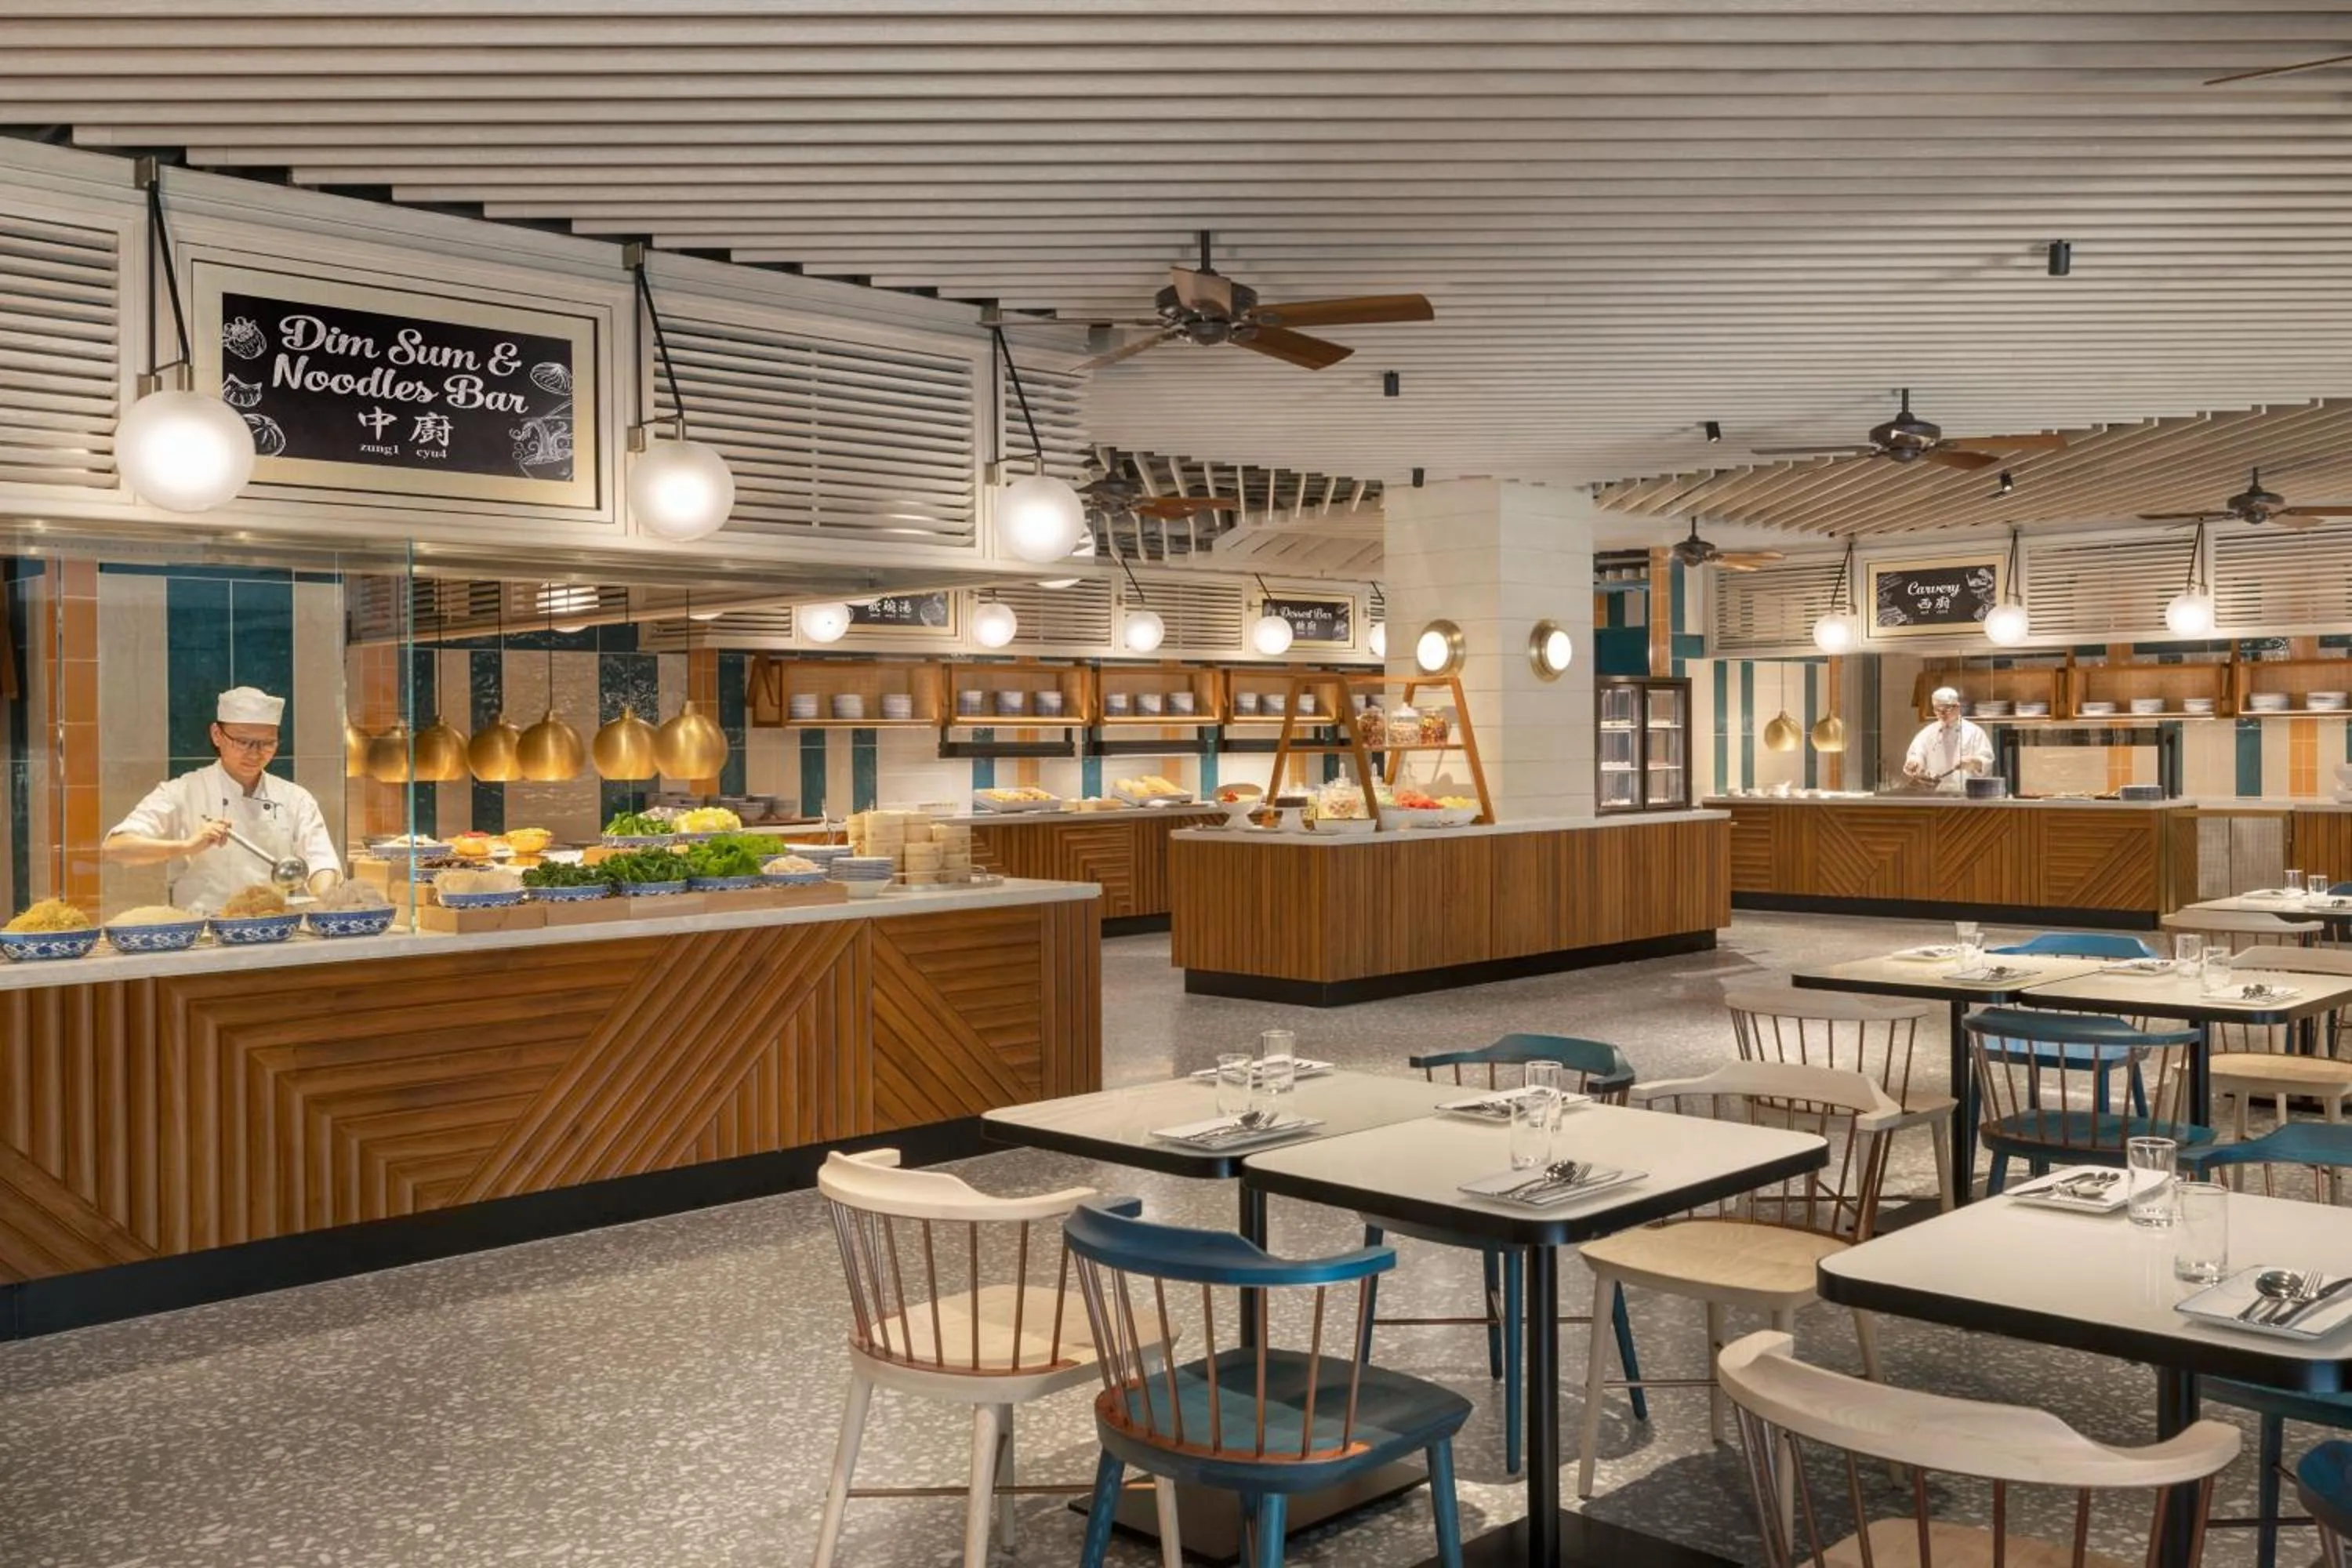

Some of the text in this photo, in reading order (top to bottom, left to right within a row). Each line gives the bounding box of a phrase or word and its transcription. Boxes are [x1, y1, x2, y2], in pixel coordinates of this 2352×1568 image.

[278, 314, 522, 376] Dim Sum &
[272, 353, 528, 414] Noodles Bar
[1907, 581, 1960, 597] Carvery
[1279, 606, 1332, 620] Dessert Bar
